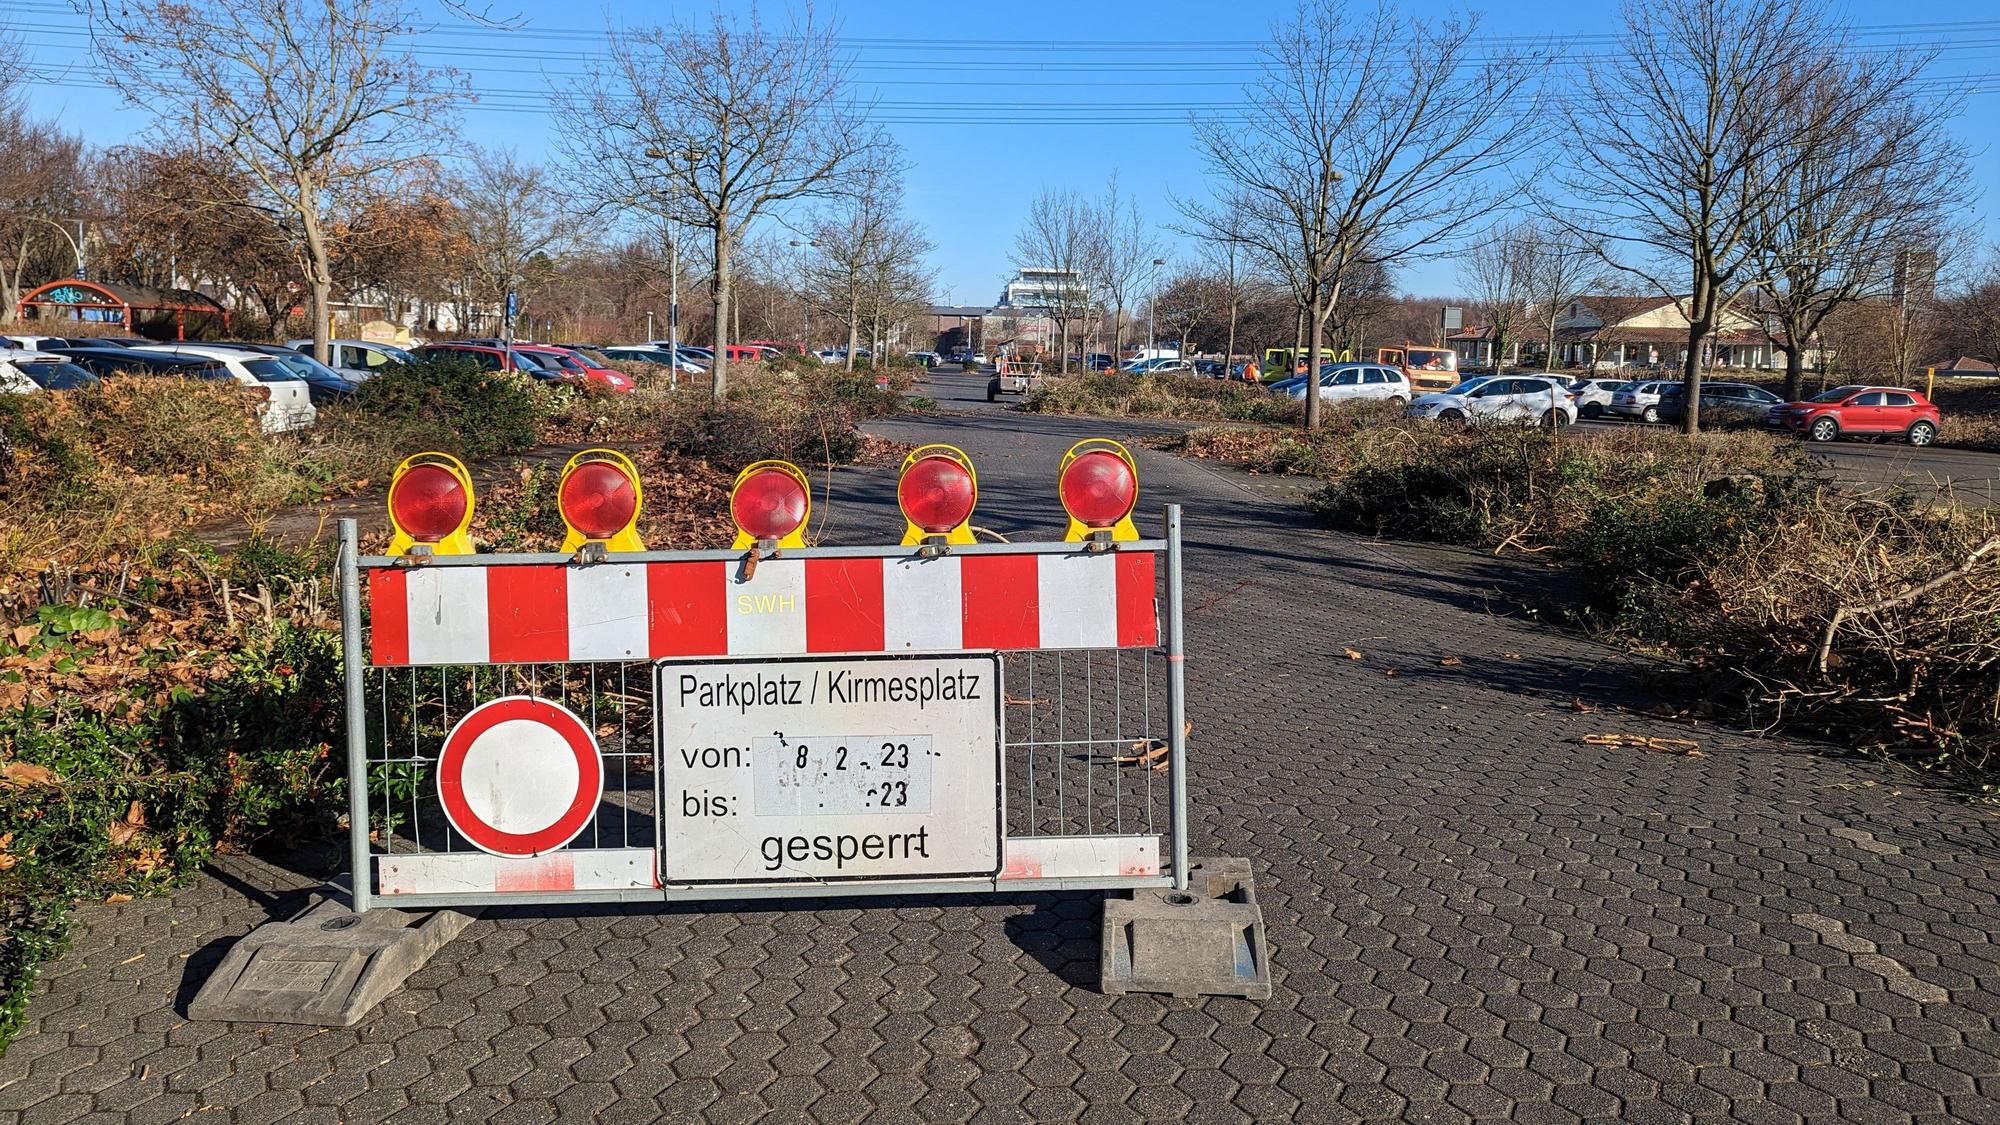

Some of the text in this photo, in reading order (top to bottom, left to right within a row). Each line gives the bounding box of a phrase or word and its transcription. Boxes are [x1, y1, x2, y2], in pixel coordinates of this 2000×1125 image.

[737, 594, 795, 615] SWH
[680, 672, 803, 716] Parkplatz
[828, 666, 982, 711] Kirmesplatz
[680, 745, 750, 769] von:
[683, 790, 737, 818] bis:
[760, 825, 930, 871] gesperrt
